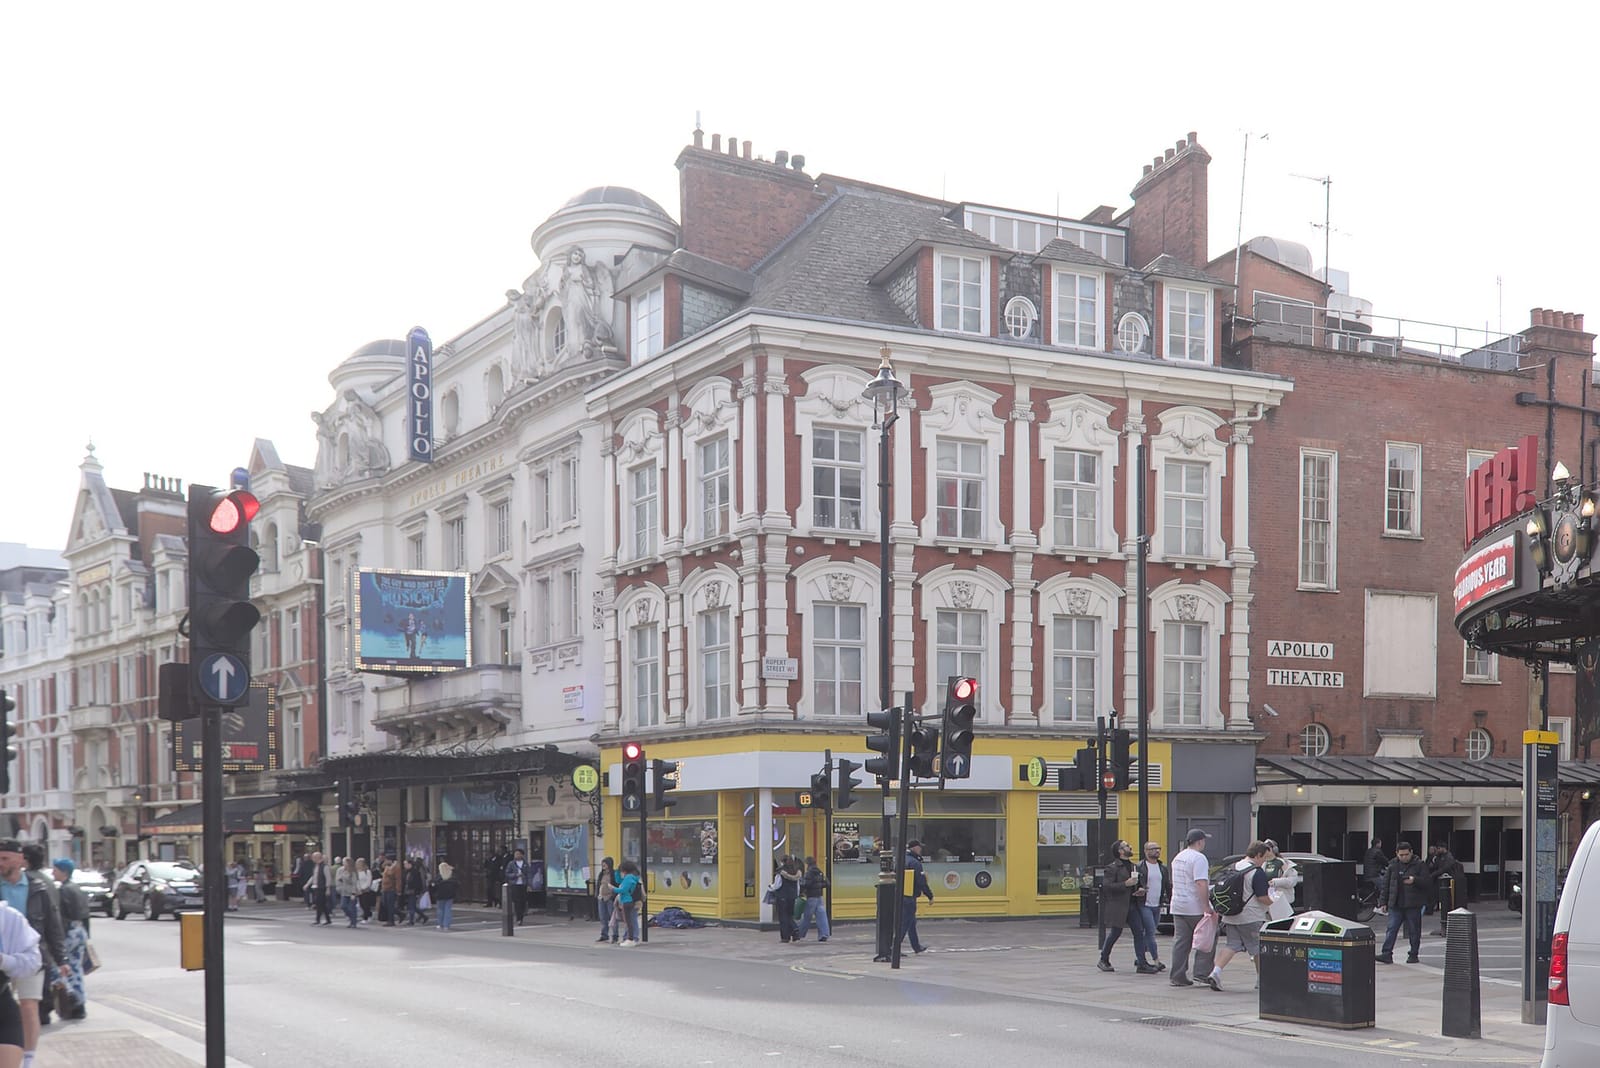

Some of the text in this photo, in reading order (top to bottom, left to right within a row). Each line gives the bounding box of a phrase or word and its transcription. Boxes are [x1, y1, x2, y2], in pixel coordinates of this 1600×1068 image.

[412, 346, 430, 454] APOLLO
[409, 453, 504, 508] APOLLO THEATRE
[1484, 555, 1506, 583] YEAR
[381, 588, 444, 609] MUSICALS
[1270, 642, 1329, 658] APOLLO
[1269, 670, 1342, 686] THEATRE
